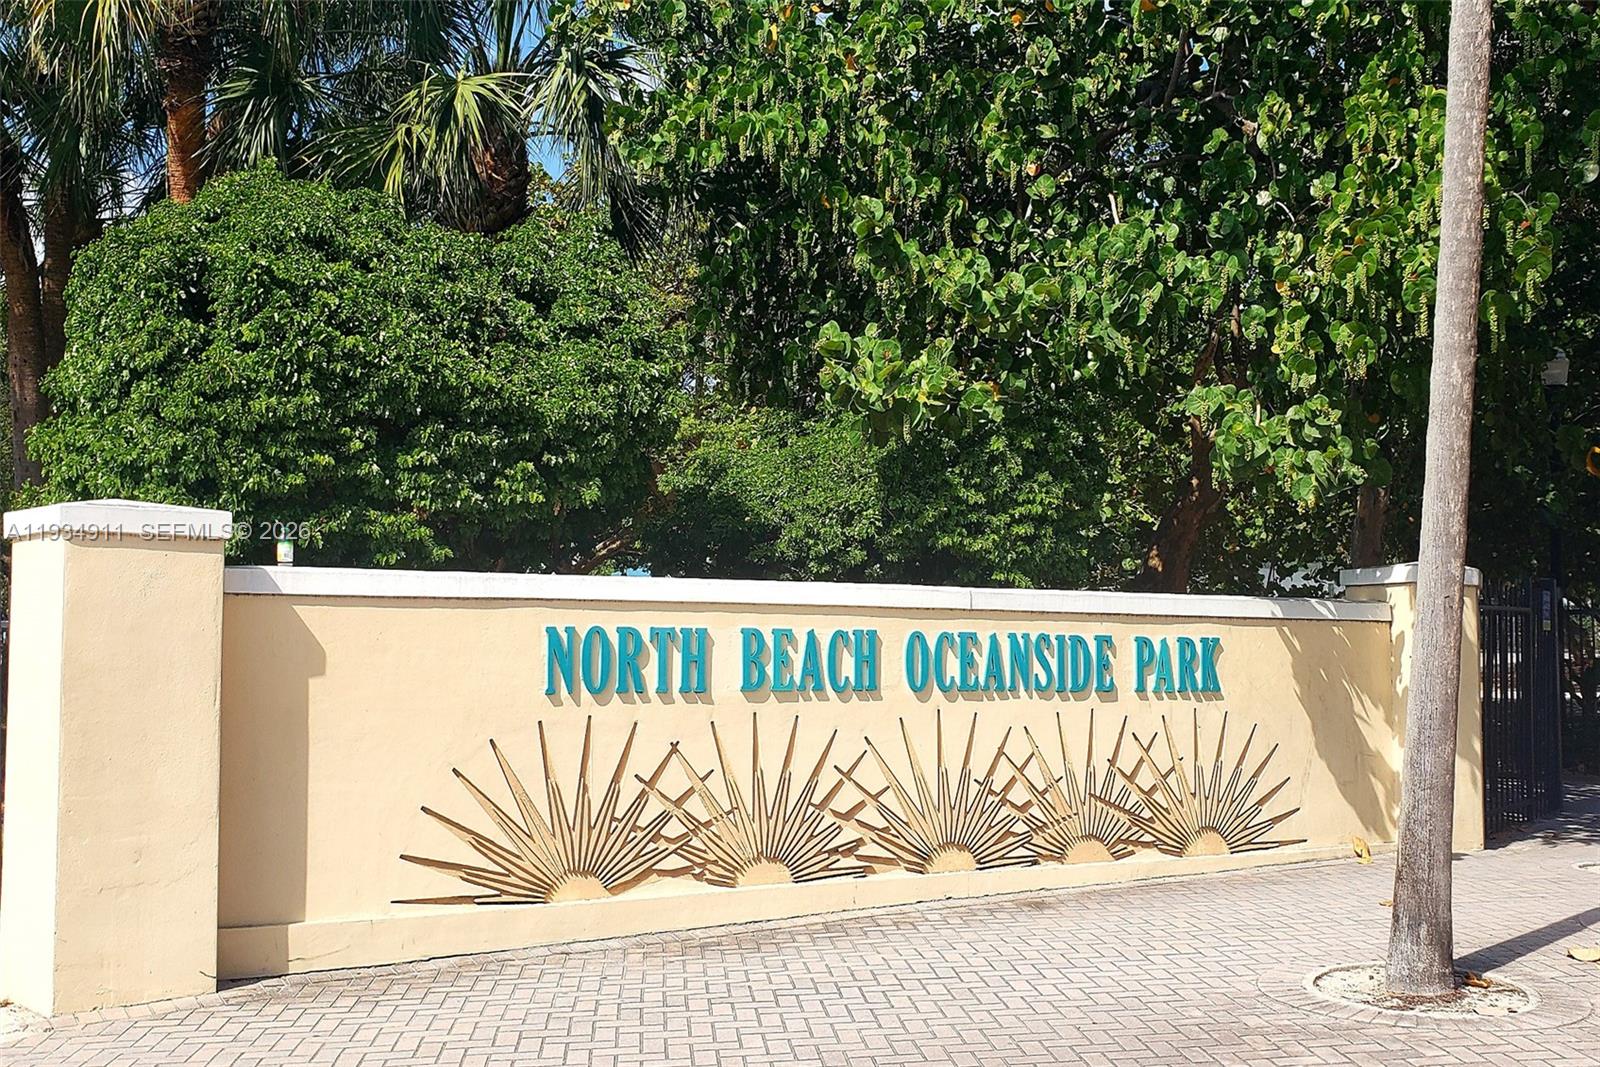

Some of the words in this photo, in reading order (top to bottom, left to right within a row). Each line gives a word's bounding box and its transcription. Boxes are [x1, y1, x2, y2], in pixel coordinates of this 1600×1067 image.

[545, 626, 708, 695] NORTH
[740, 627, 877, 693] BEACH
[905, 630, 1115, 693] OCEANSIDE
[1134, 636, 1221, 693] PARK
